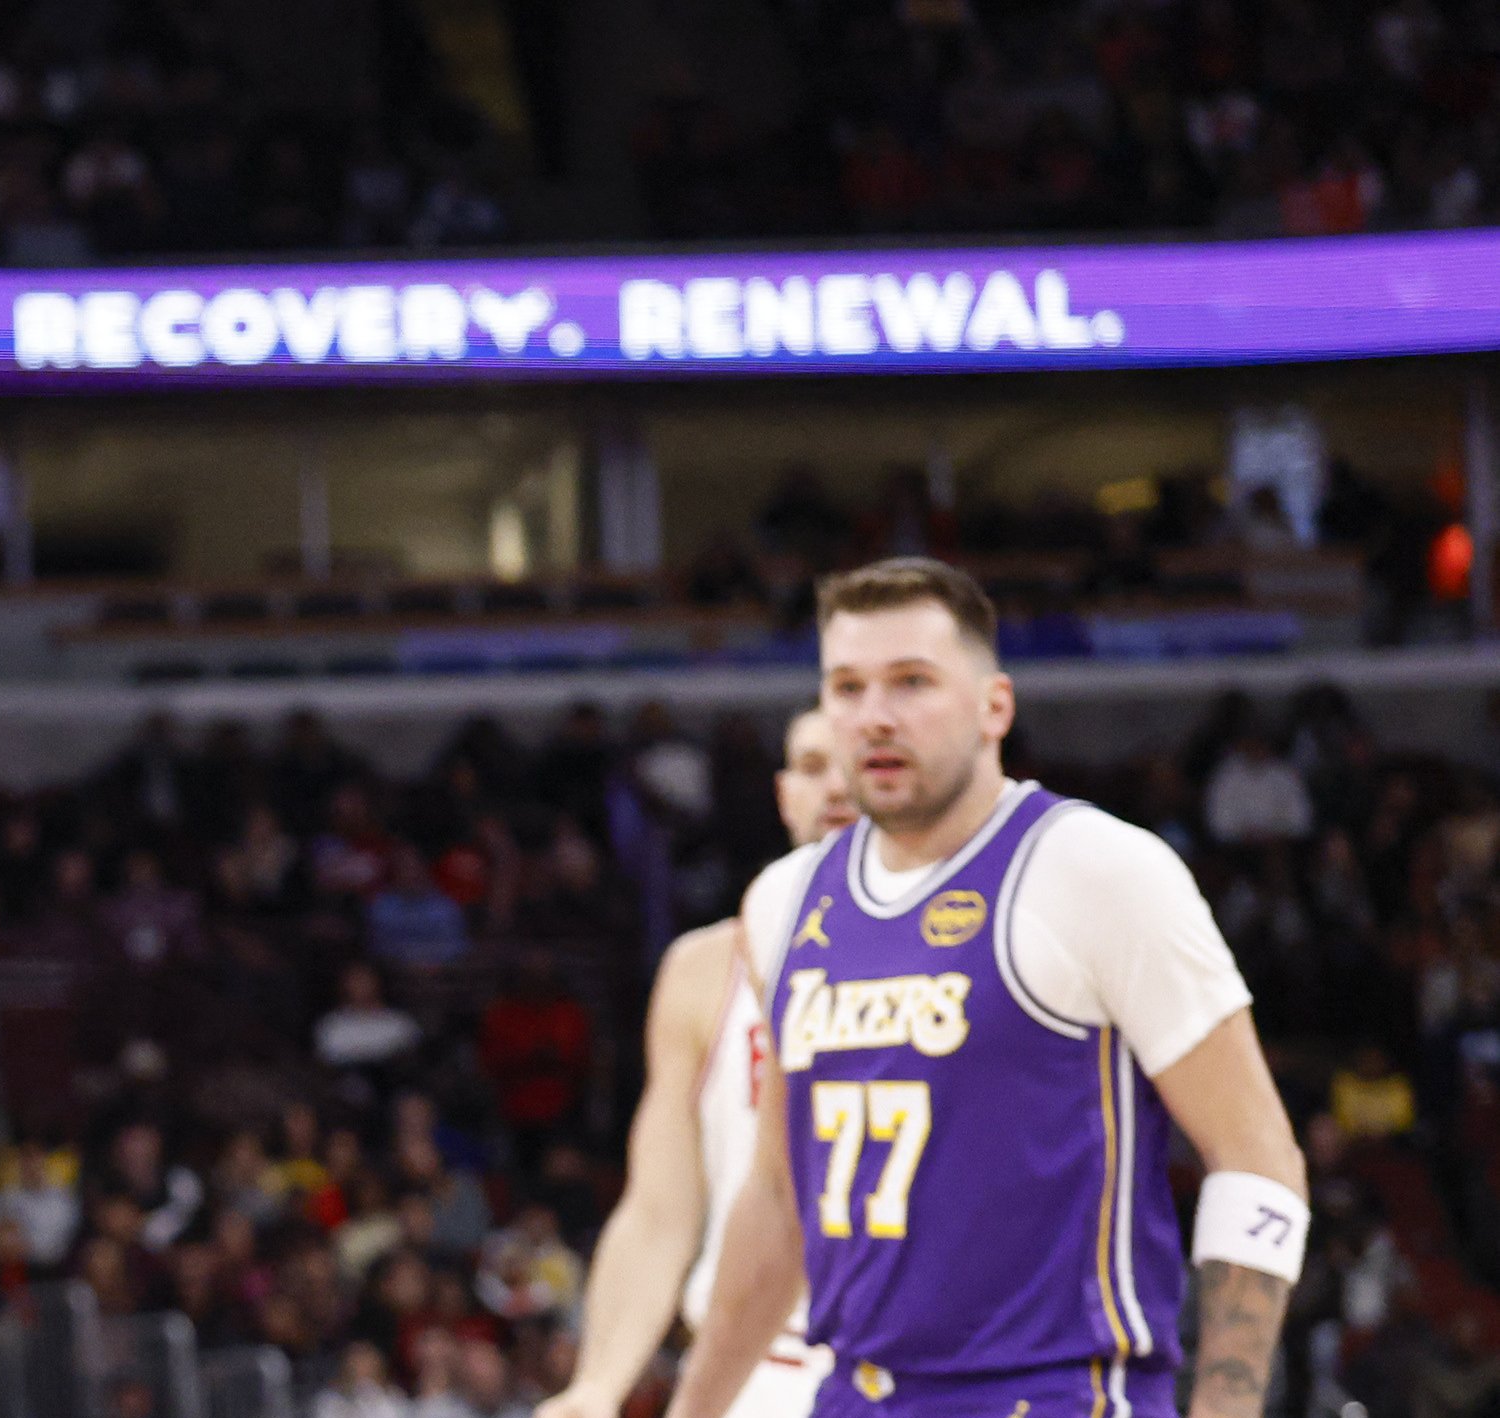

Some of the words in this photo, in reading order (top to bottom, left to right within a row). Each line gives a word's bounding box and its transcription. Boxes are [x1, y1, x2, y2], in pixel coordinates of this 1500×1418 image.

[13, 285, 586, 369] RECOVERY.
[619, 268, 1126, 361] RENEWAL.
[779, 967, 973, 1073] LAKERS
[811, 1079, 932, 1240] 77
[1246, 1204, 1293, 1249] 77
